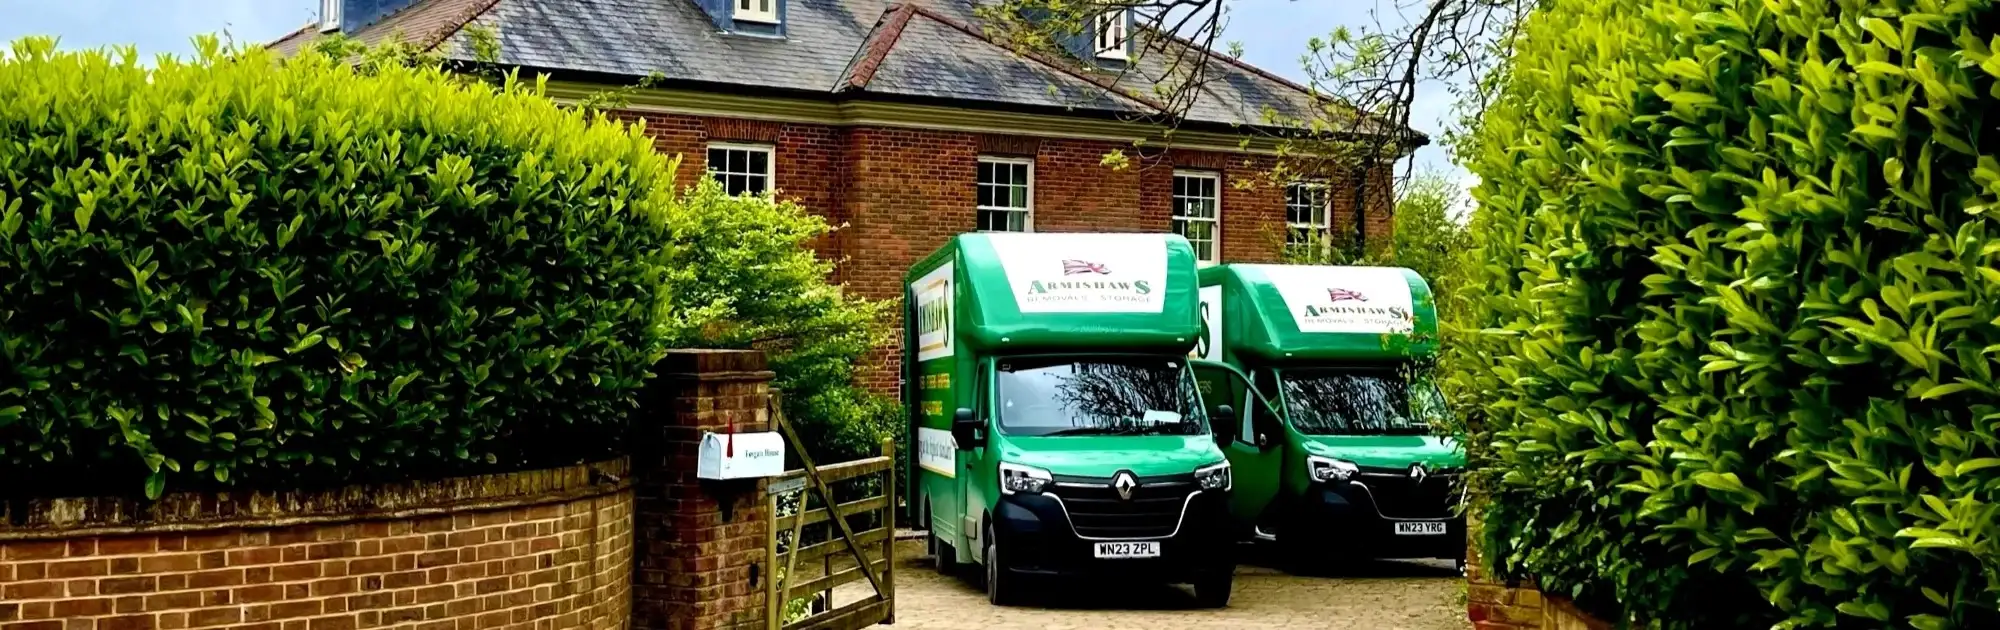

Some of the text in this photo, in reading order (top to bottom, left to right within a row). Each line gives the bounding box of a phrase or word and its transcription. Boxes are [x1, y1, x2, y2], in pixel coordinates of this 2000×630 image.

[1027, 279, 1151, 295] ARMISHAWS
[1027, 294, 1151, 304] REMOVALS STORAGE
[1304, 304, 1402, 319] ARMISHAWS
[1399, 522, 1443, 533] WN23 YRG
[1100, 543, 1156, 556] WN23 ZPL
